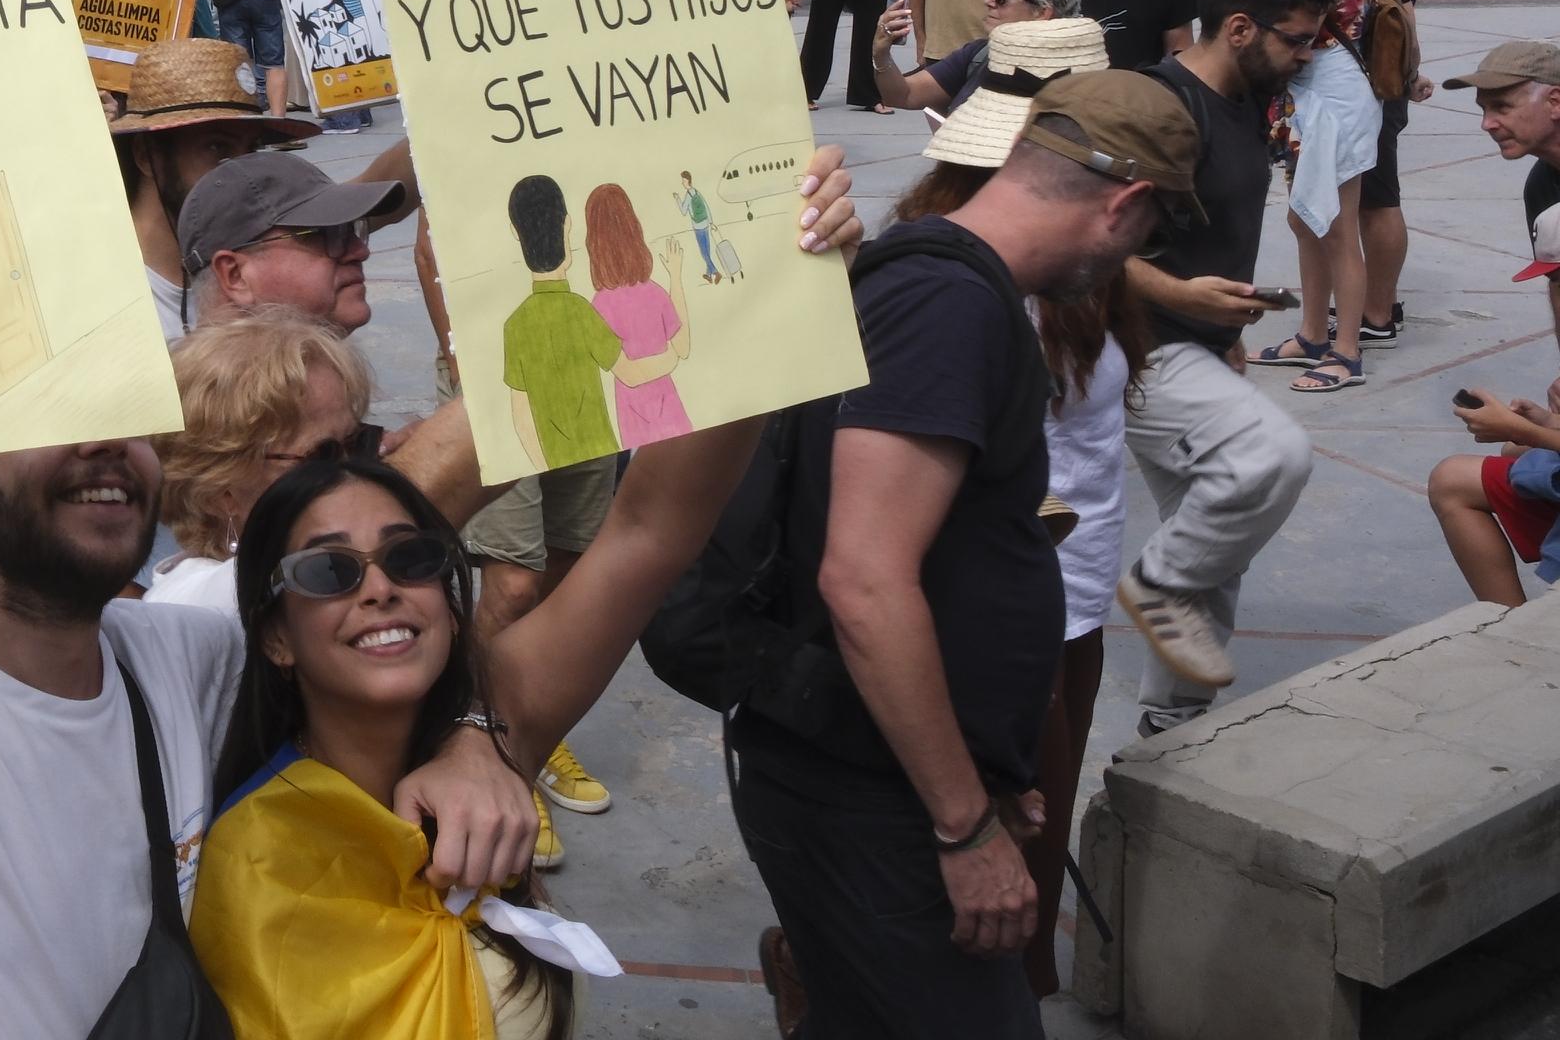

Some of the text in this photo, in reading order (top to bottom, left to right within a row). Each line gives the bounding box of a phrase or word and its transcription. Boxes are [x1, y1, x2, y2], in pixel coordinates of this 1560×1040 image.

[117, 2, 160, 24] LIMPIA
[78, 15, 158, 42] COSTAS VIVAS
[484, 70, 564, 144] SE
[566, 43, 730, 127] VAYAN
